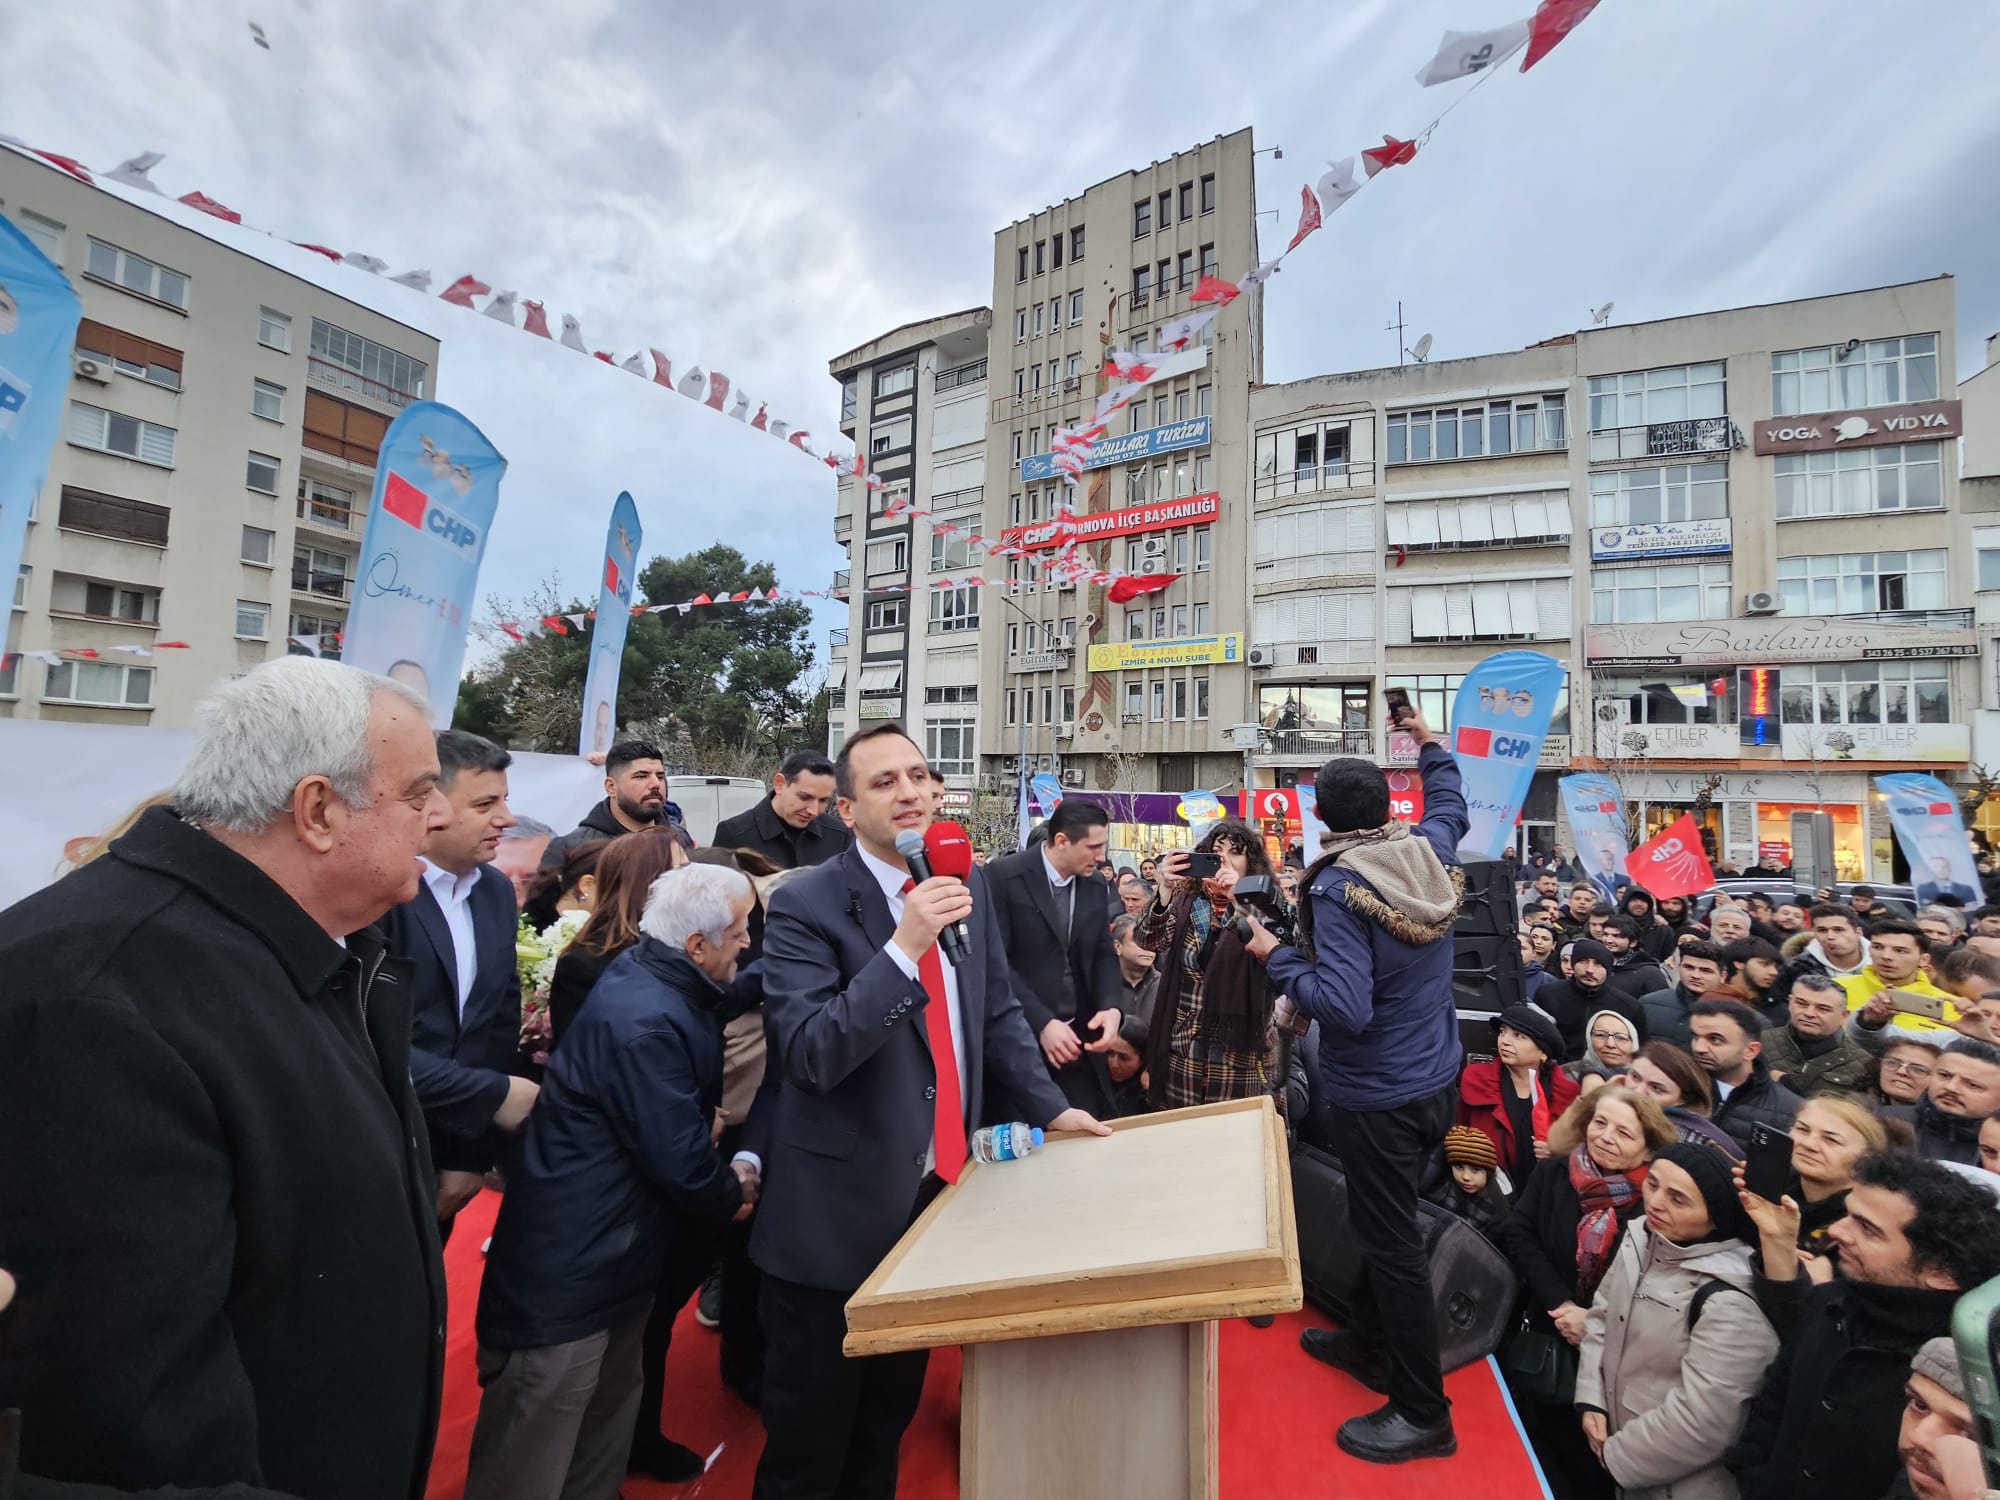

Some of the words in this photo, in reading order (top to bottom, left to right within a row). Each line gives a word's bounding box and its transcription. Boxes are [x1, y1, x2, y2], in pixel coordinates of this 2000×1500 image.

[1156, 421, 1206, 446] TURİZM
[1767, 426, 1822, 442] YOGA
[1883, 412, 1949, 432] VİDYA
[1122, 451, 1134, 459] 07
[427, 508, 476, 549] CHP
[1024, 526, 1058, 545] CHP
[1118, 514, 1141, 529] İLÇE
[1144, 496, 1216, 524] BAŞKANLIĞI
[1157, 655, 1183, 664] NOLU
[1866, 650, 1881, 658] 343
[1918, 648, 1933, 656] 537
[1651, 838, 1684, 863] CHP
